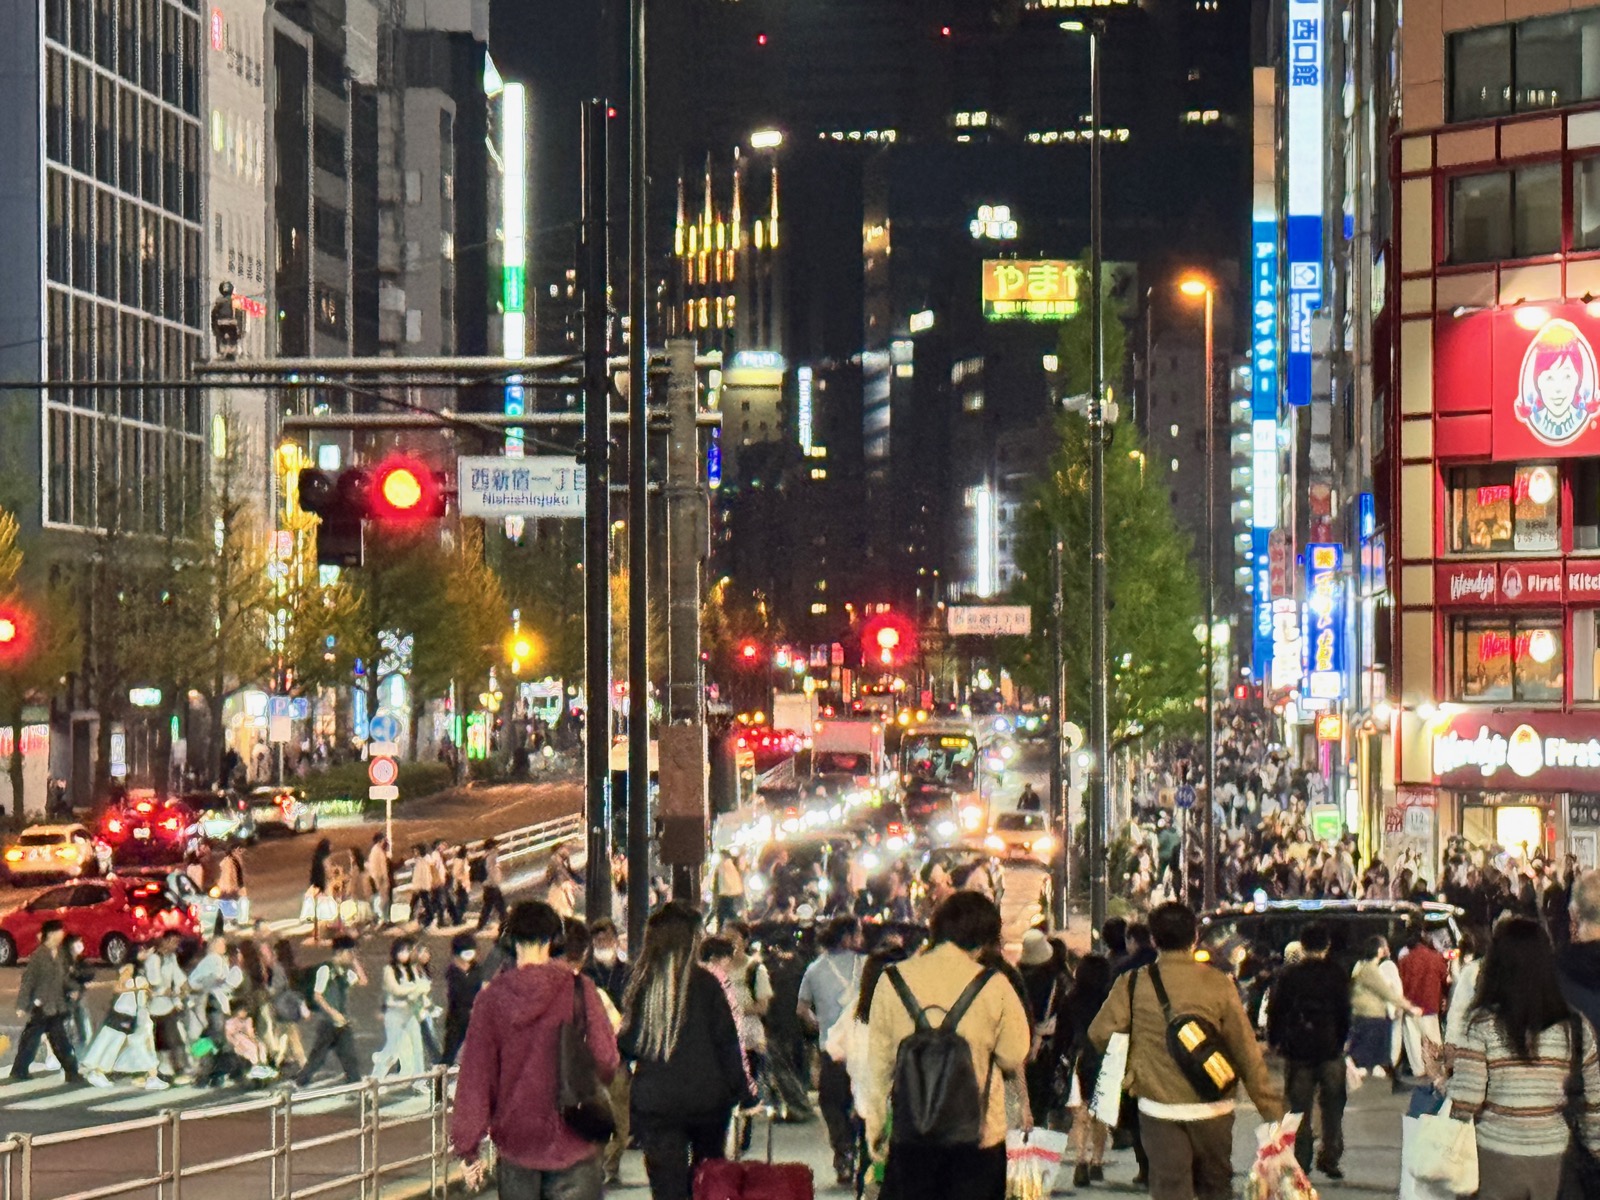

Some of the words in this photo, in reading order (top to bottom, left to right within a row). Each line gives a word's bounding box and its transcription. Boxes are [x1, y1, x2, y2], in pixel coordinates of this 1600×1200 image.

[1292, 18, 1318, 86] 西口館
[1527, 574, 1561, 592] First
[1569, 572, 1600, 591] Kitc
